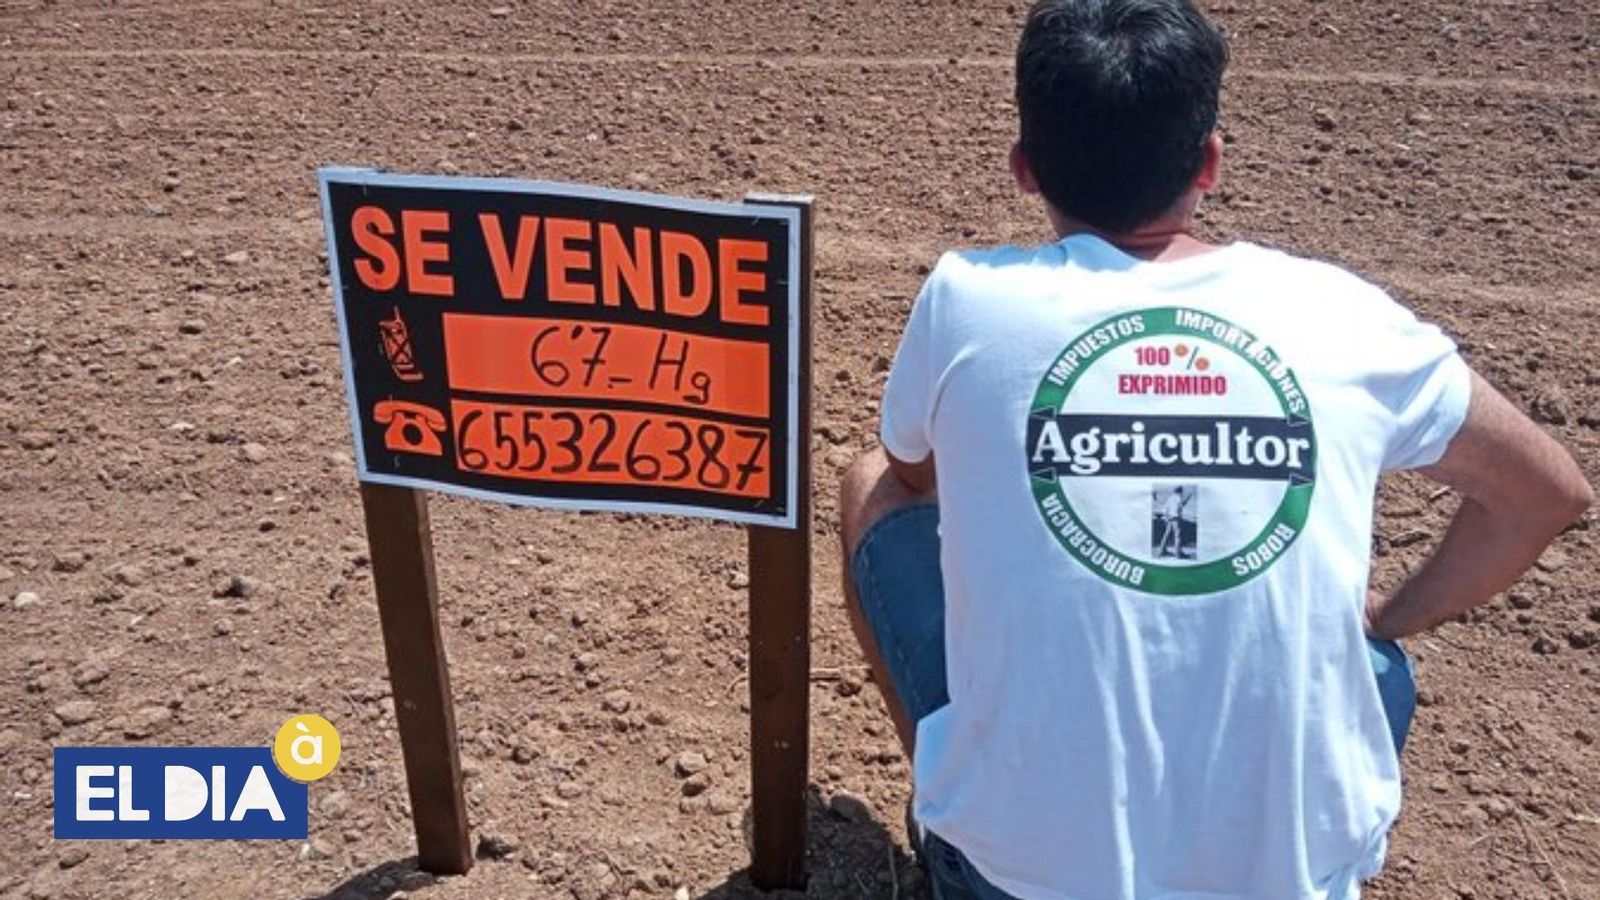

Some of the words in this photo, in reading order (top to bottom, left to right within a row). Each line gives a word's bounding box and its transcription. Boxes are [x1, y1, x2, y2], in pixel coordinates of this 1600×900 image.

[351, 206, 454, 297] SE
[478, 212, 770, 326] VENDE
[1047, 314, 1146, 386] IMPUESTOS
[1117, 373, 1228, 396] EXPRIMIDO
[1174, 308, 1306, 413] IMPORTCIONES
[457, 410, 768, 490] 655326387
[1032, 420, 1310, 474] Agricultor
[1041, 492, 1146, 586] BUROCRACIA
[1231, 522, 1296, 577] ROBOS
